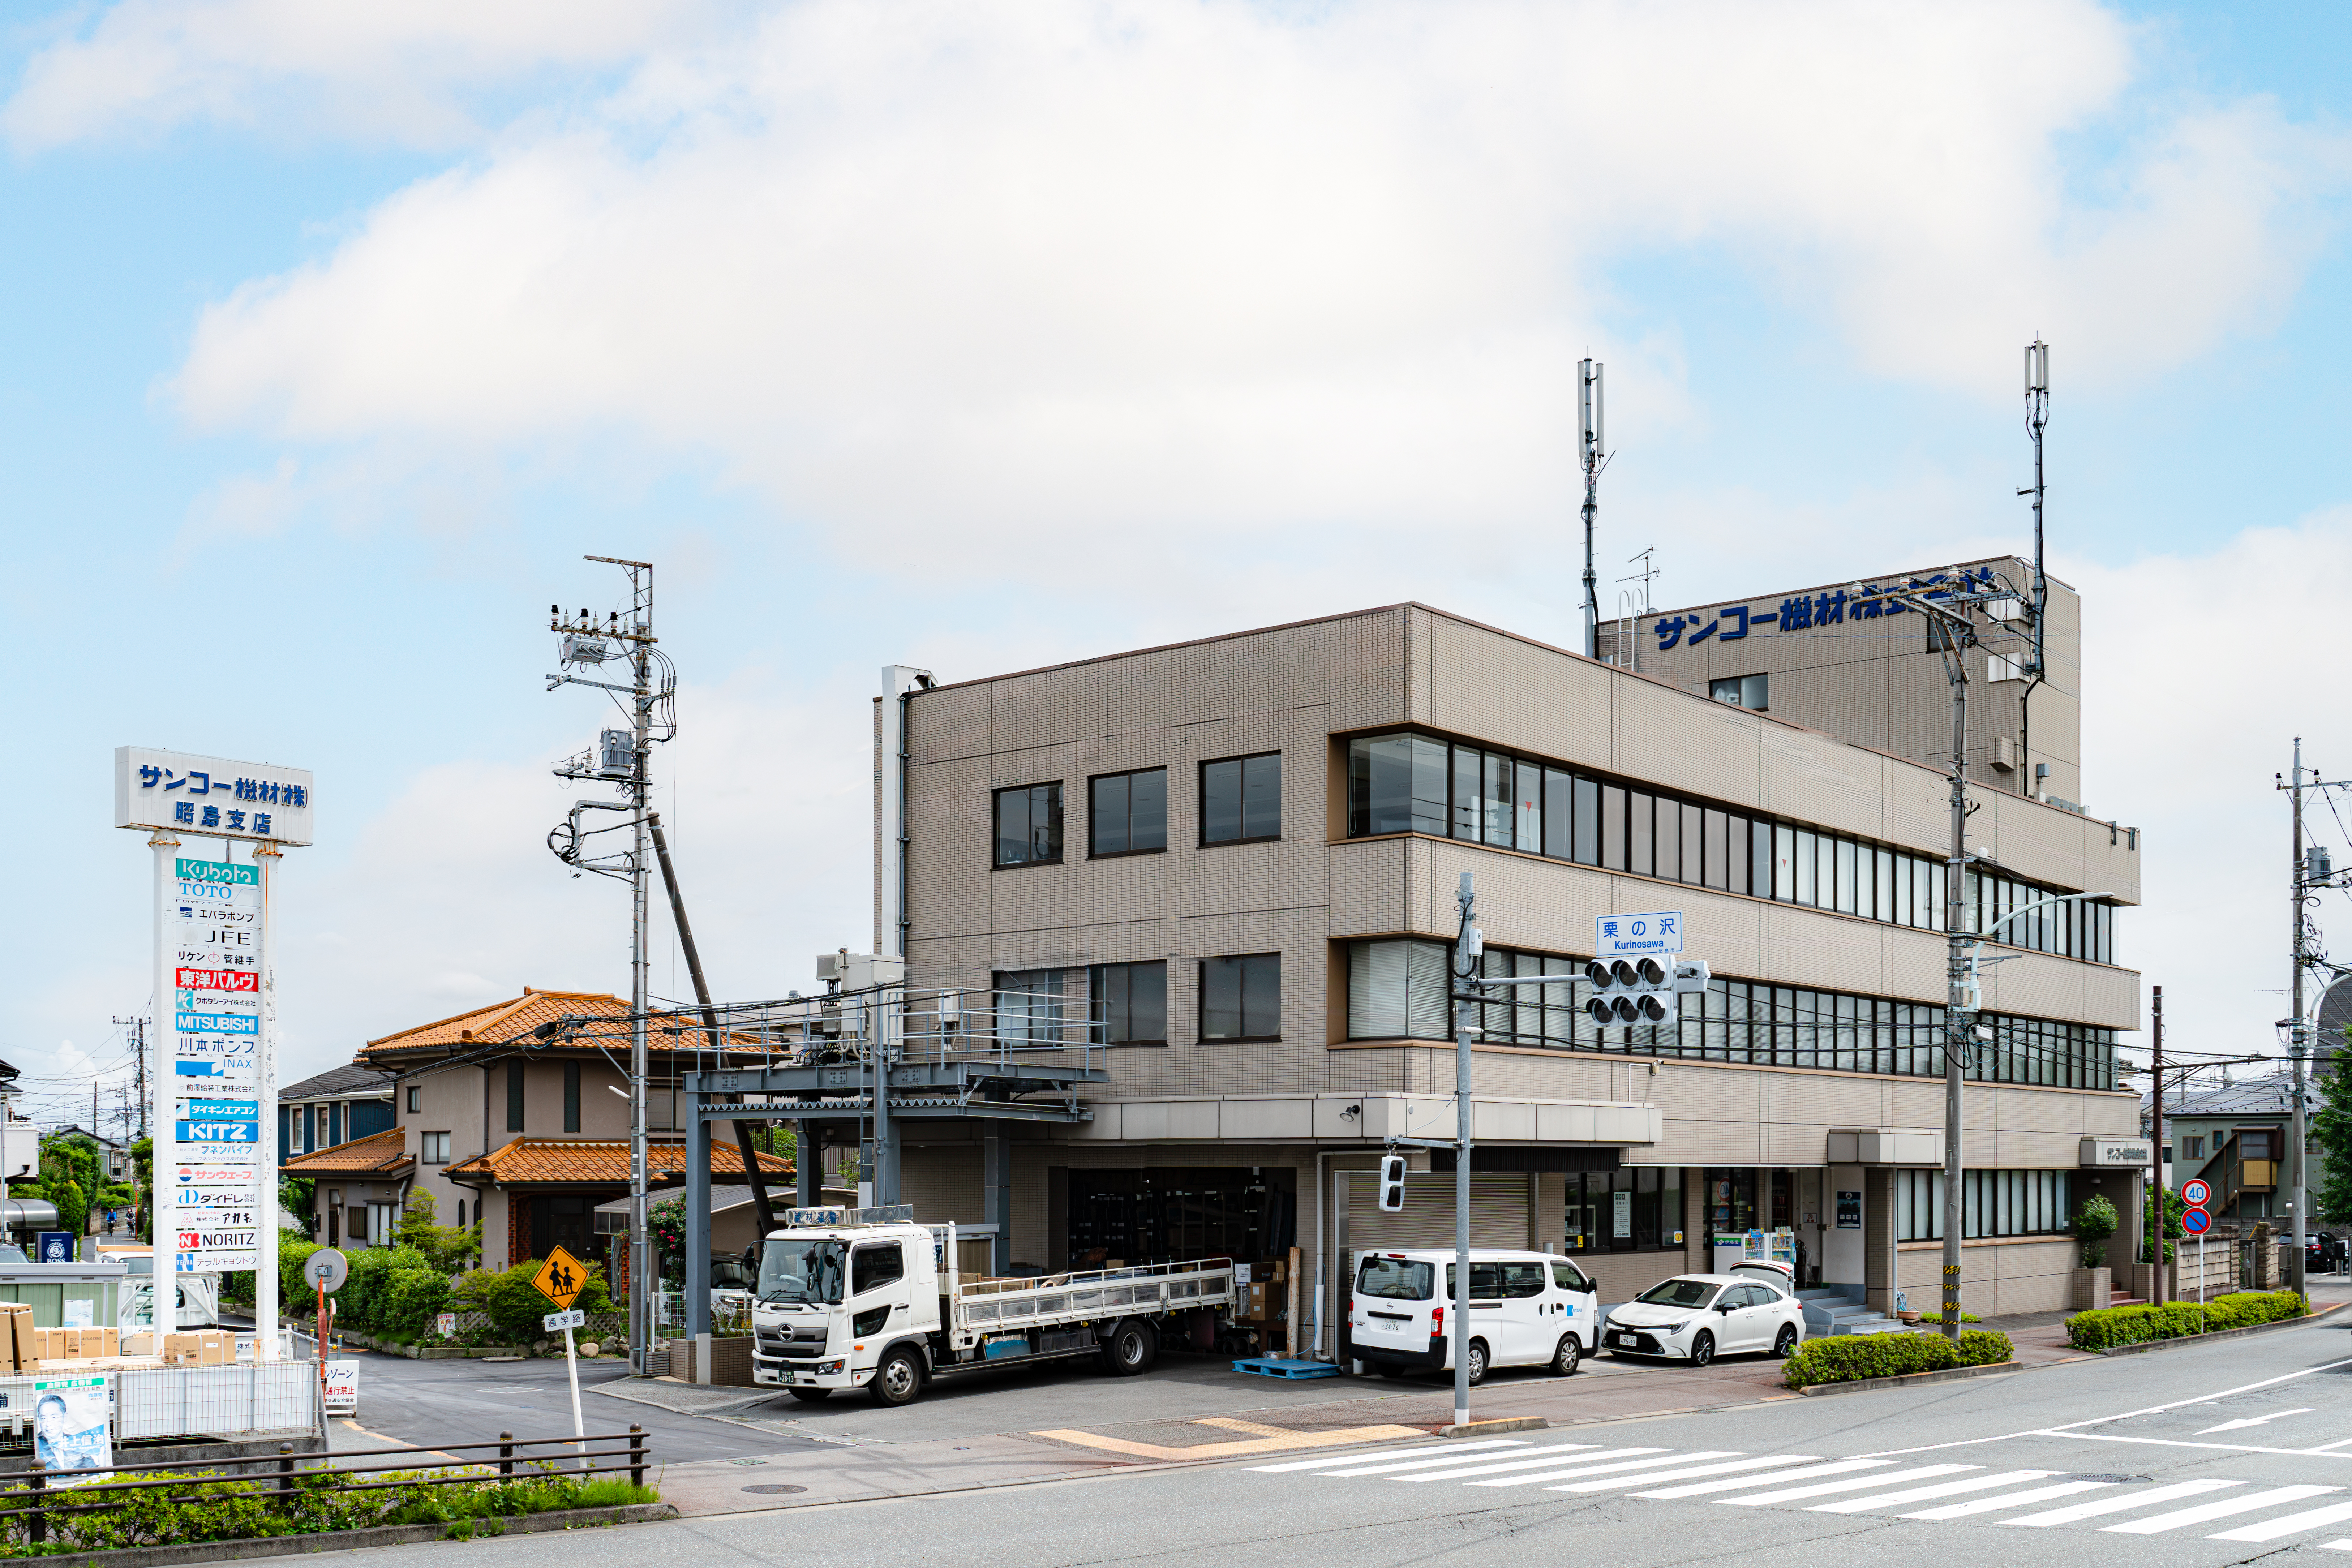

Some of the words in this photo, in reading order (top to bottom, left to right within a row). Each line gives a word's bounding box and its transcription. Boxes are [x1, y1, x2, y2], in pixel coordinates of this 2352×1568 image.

[175, 801, 271, 834] 昭島支店
[183, 860, 251, 883] Kubota
[179, 882, 231, 899] TOTO
[199, 909, 254, 922] エバラポンプ
[1603, 918, 1675, 938] 栗の沢
[204, 930, 250, 945] JFE
[1615, 940, 1664, 950] Kurinosawa
[179, 951, 205, 961] リケン
[224, 954, 255, 965] 管継手
[179, 970, 254, 989] 東洋バルヴ
[196, 997, 256, 1006] クボタシーアイ株式会社
[178, 1015, 255, 1031] MITSUBISHI
[179, 1038, 254, 1053] 川本ポンプ
[223, 1059, 252, 1069] INAX
[191, 1105, 257, 1115] ダイキンエアコン
[189, 1123, 247, 1140] KITZ
[201, 1145, 253, 1154] フネンパイプ
[201, 1194, 243, 1203] ダイドレ
[2188, 1187, 2204, 1199] 40
[222, 1213, 253, 1224] アカギ
[203, 1233, 254, 1246] NORITZ
[196, 1256, 256, 1266] テラルキョクトウ
[548, 1314, 581, 1327] 通学路
[326, 1386, 355, 1395] 通行禁止
[58, 1434, 104, 1448] 井上信治
